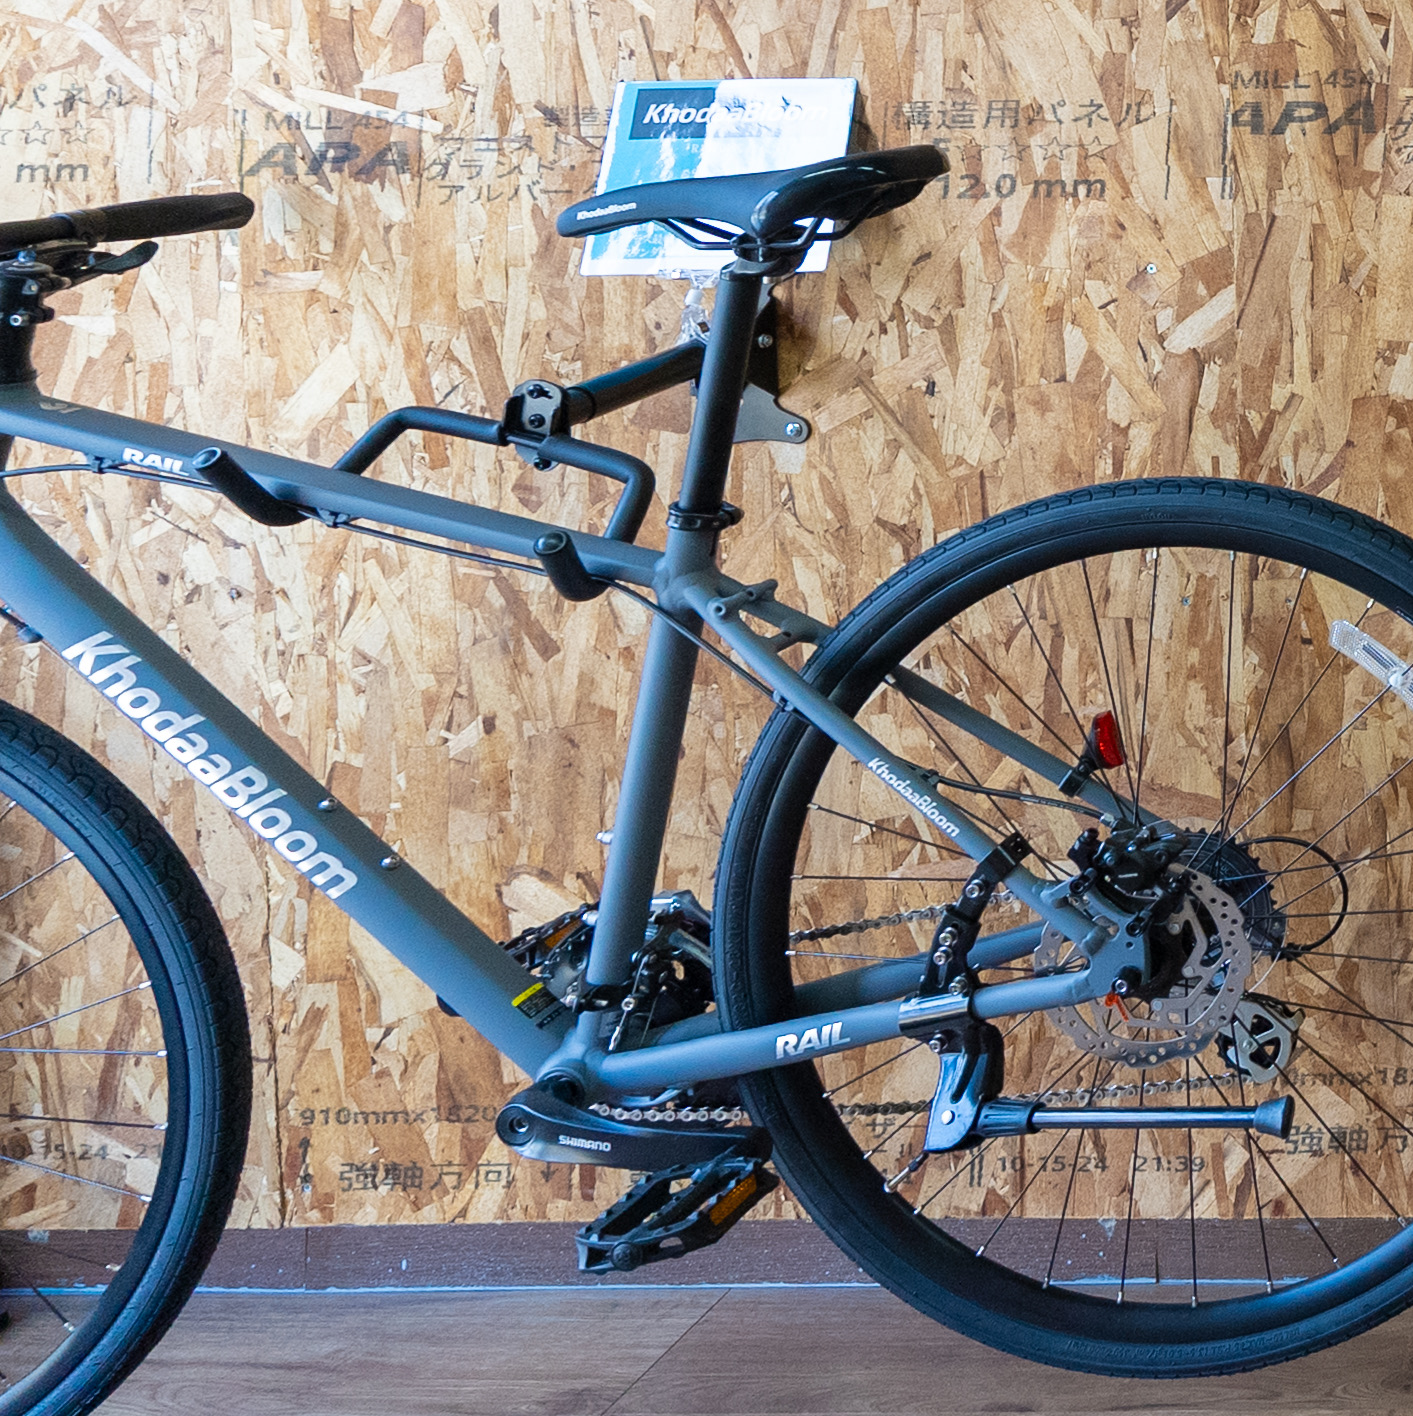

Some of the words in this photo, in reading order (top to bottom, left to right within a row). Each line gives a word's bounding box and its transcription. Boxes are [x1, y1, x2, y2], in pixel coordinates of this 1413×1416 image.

[1232, 70, 1311, 90] MILL
[1231, 100, 1377, 135] APA
[245, 141, 412, 177] APA
[1033, 177, 1107, 199] mm
[121, 446, 190, 477] RAIL
[61, 630, 359, 900] KhodaaBloom
[867, 756, 961, 840] KhodaaBloom
[774, 1021, 852, 1060] RAIL
[557, 1133, 612, 1153] SHIMANO
